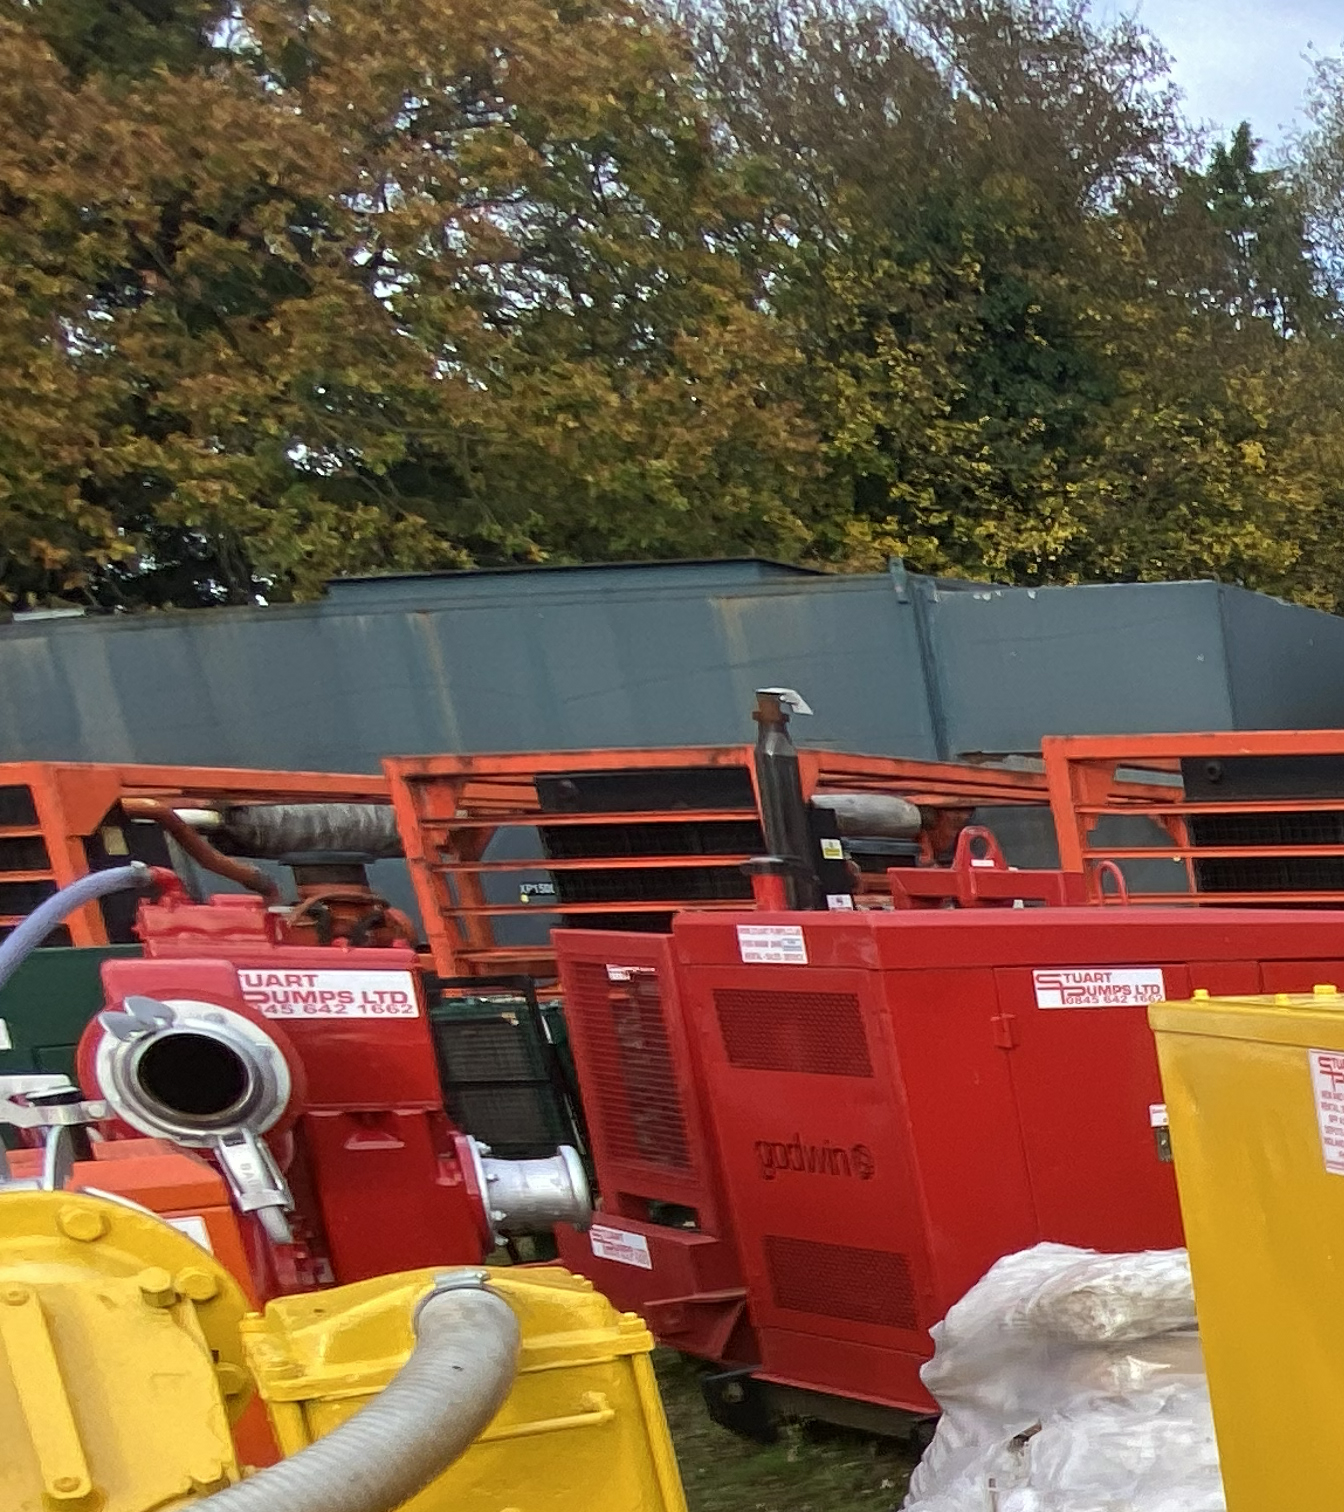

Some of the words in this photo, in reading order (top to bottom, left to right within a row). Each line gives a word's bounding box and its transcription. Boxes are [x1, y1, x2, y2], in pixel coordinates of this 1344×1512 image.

[239, 974, 319, 988] UART
[1036, 973, 1112, 990] STUART
[362, 991, 408, 1004] LTD
[1061, 984, 1131, 1004] PUMPS
[1135, 984, 1160, 995] LTD
[258, 1004, 294, 1015] 45
[303, 1004, 349, 1015] 642
[357, 1004, 414, 1015] 1662
[754, 1132, 852, 1180] godwin
